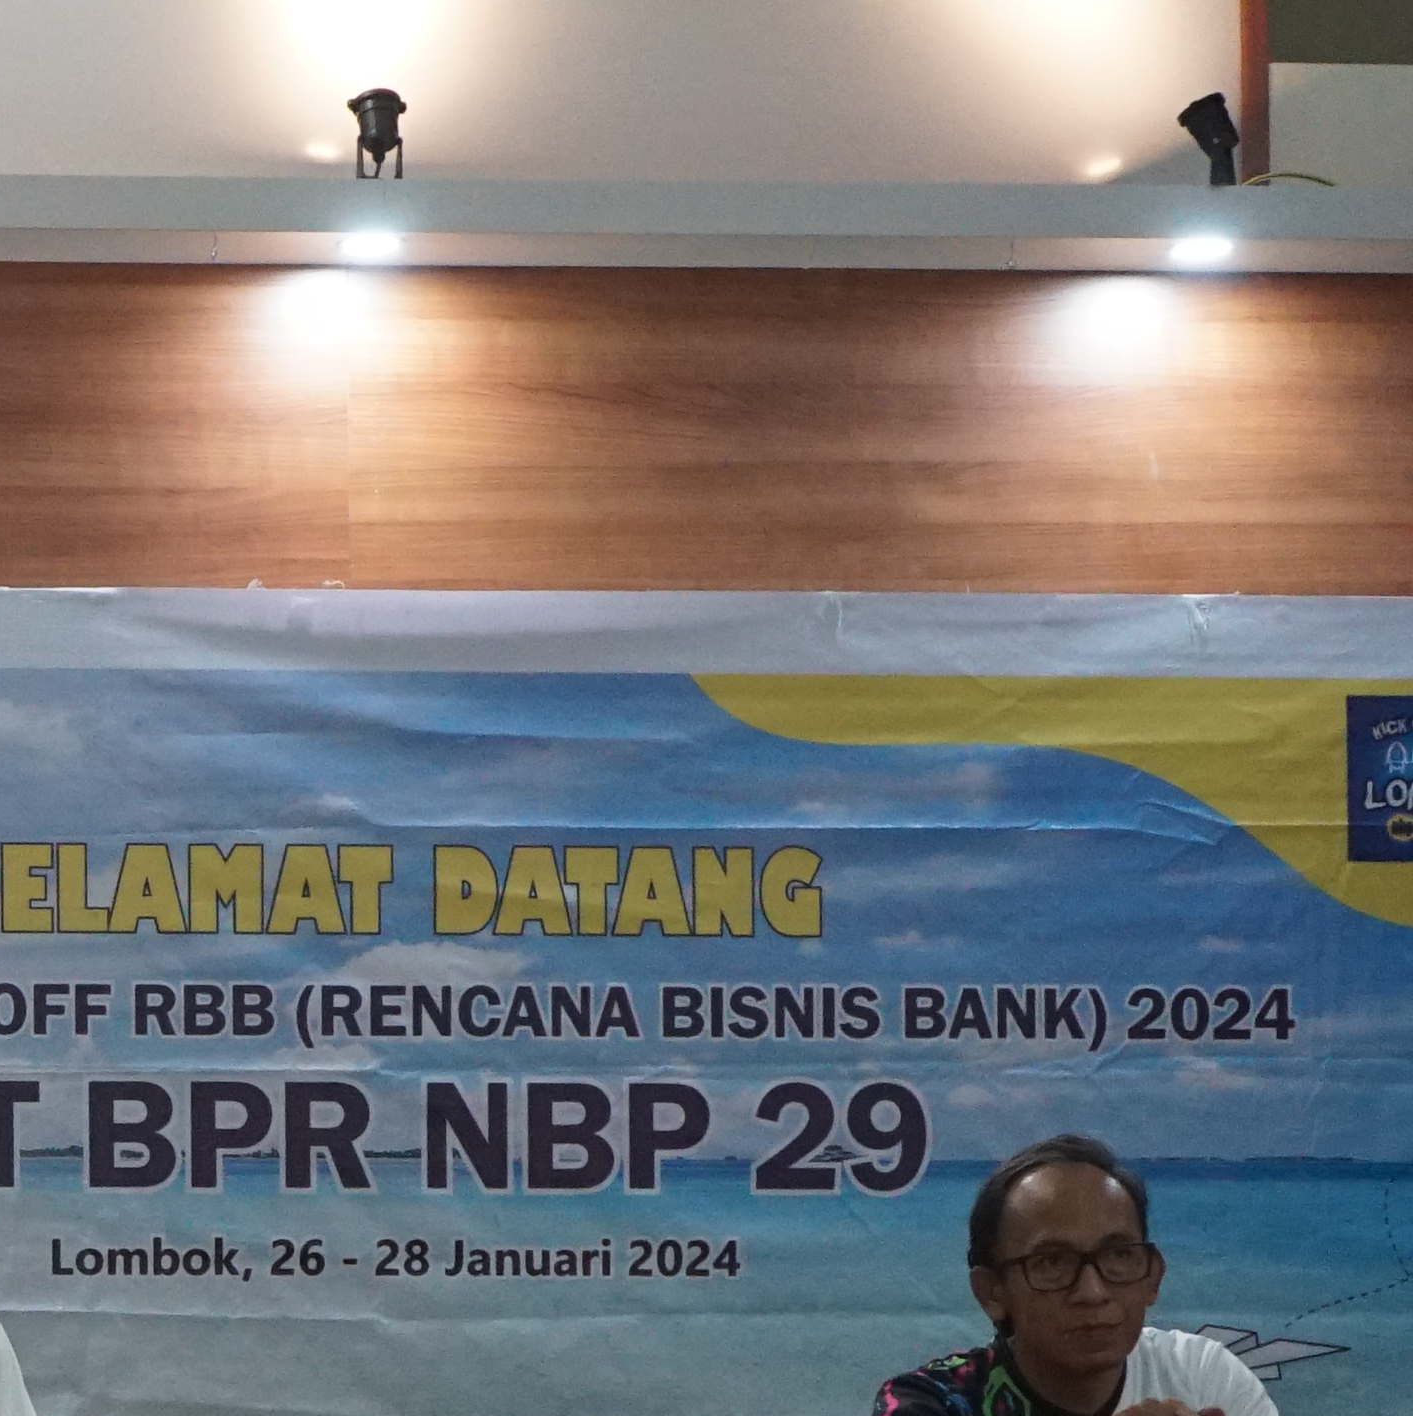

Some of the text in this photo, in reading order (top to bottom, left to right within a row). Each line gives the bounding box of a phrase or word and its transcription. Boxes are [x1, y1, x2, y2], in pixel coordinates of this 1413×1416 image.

[1363, 778, 1413, 810] LO
[433, 844, 823, 938] DATANG
[132, 983, 275, 1037] RBB
[295, 984, 640, 1049] (RENCANA
[661, 985, 882, 1040] BISNIS
[903, 986, 1108, 1052] BANK)
[1126, 987, 1295, 1041] 2024
[86, 1081, 373, 1190] BPR
[425, 1081, 711, 1190] NBP
[754, 1081, 928, 1192] 29
[50, 1237, 254, 1281] Lombok,
[270, 1239, 326, 1277] 26
[374, 1239, 431, 1277] 28
[444, 1237, 613, 1278] Januari
[627, 1239, 742, 1277] 2024
